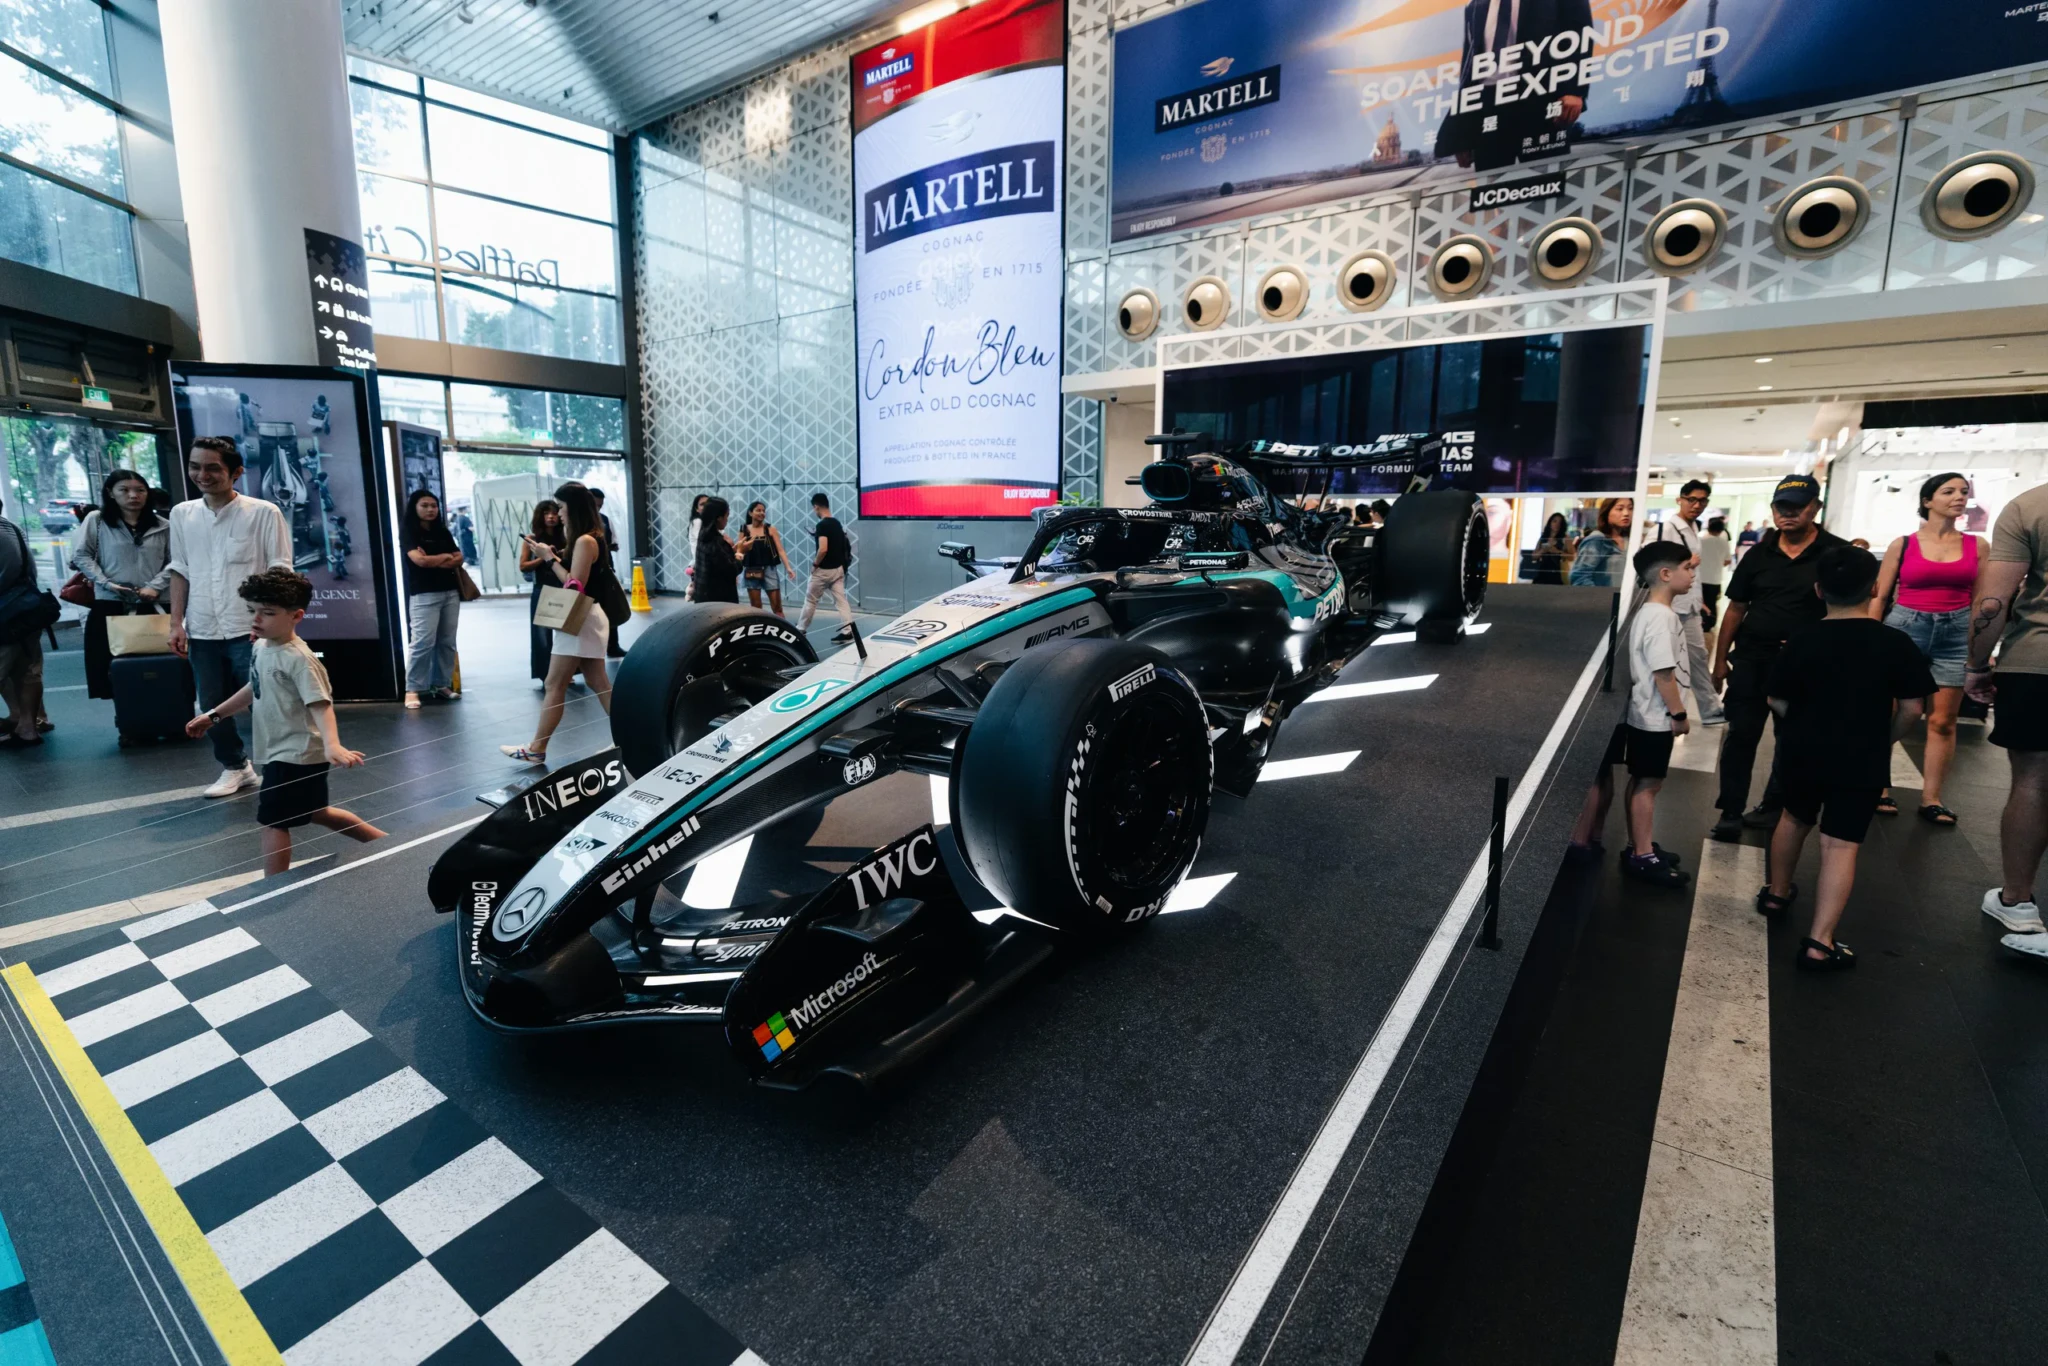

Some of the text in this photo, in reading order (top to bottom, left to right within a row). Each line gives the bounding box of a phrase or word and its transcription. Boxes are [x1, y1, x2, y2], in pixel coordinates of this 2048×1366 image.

[2004, 2, 2048, 18] MARTE
[866, 57, 912, 86] MARTELL
[1361, 14, 1645, 108] SOAR BEYOND
[1412, 26, 1730, 123] THE EXPECTED
[1162, 76, 1273, 125] MARTELL
[1195, 119, 1234, 134] COGNAC
[1161, 128, 1271, 161] FONDÉE EN 1715
[1522, 141, 1566, 154] TONY LEUNG
[873, 158, 1044, 237] MARTELL
[1473, 181, 1561, 207] JCDecaux
[1130, 222, 1145, 234] ENJOY
[923, 231, 984, 253] COGNAC
[873, 262, 1043, 303] FONDÉE EN 1715
[865, 319, 1055, 400] Cordon Bleu
[879, 393, 1036, 420] EXTRA OLD COGNAC
[884, 440, 931, 453] APPELLATION
[934, 438, 966, 448] COGNAC
[1268, 438, 1407, 457] PETONAS
[884, 454, 922, 466] PRODUCED
[932, 452, 968, 461] BOTTLED
[982, 452, 1017, 460] FRANCE
[1371, 463, 1473, 474] FORMU TEAM
[1121, 509, 1173, 519] CROWDSTRIKE
[312, 589, 360, 600] LGENCE
[1044, 615, 1090, 639] AMG
[708, 623, 799, 658] P ZERO
[1107, 662, 1157, 703] PIRELLI
[685, 750, 728, 764] CROWDSTRIKE
[652, 765, 703, 786] INEOS
[844, 755, 877, 783] FIA
[523, 759, 623, 823] INEOS
[627, 789, 665, 805] PIRELLI
[595, 810, 641, 830] AKKODIS
[567, 836, 598, 853] SAP
[600, 815, 701, 896] Einhell
[847, 831, 937, 911] IWC
[721, 916, 791, 931] PETRON
[703, 940, 767, 963] Synt
[790, 951, 881, 1030] Microsoft
